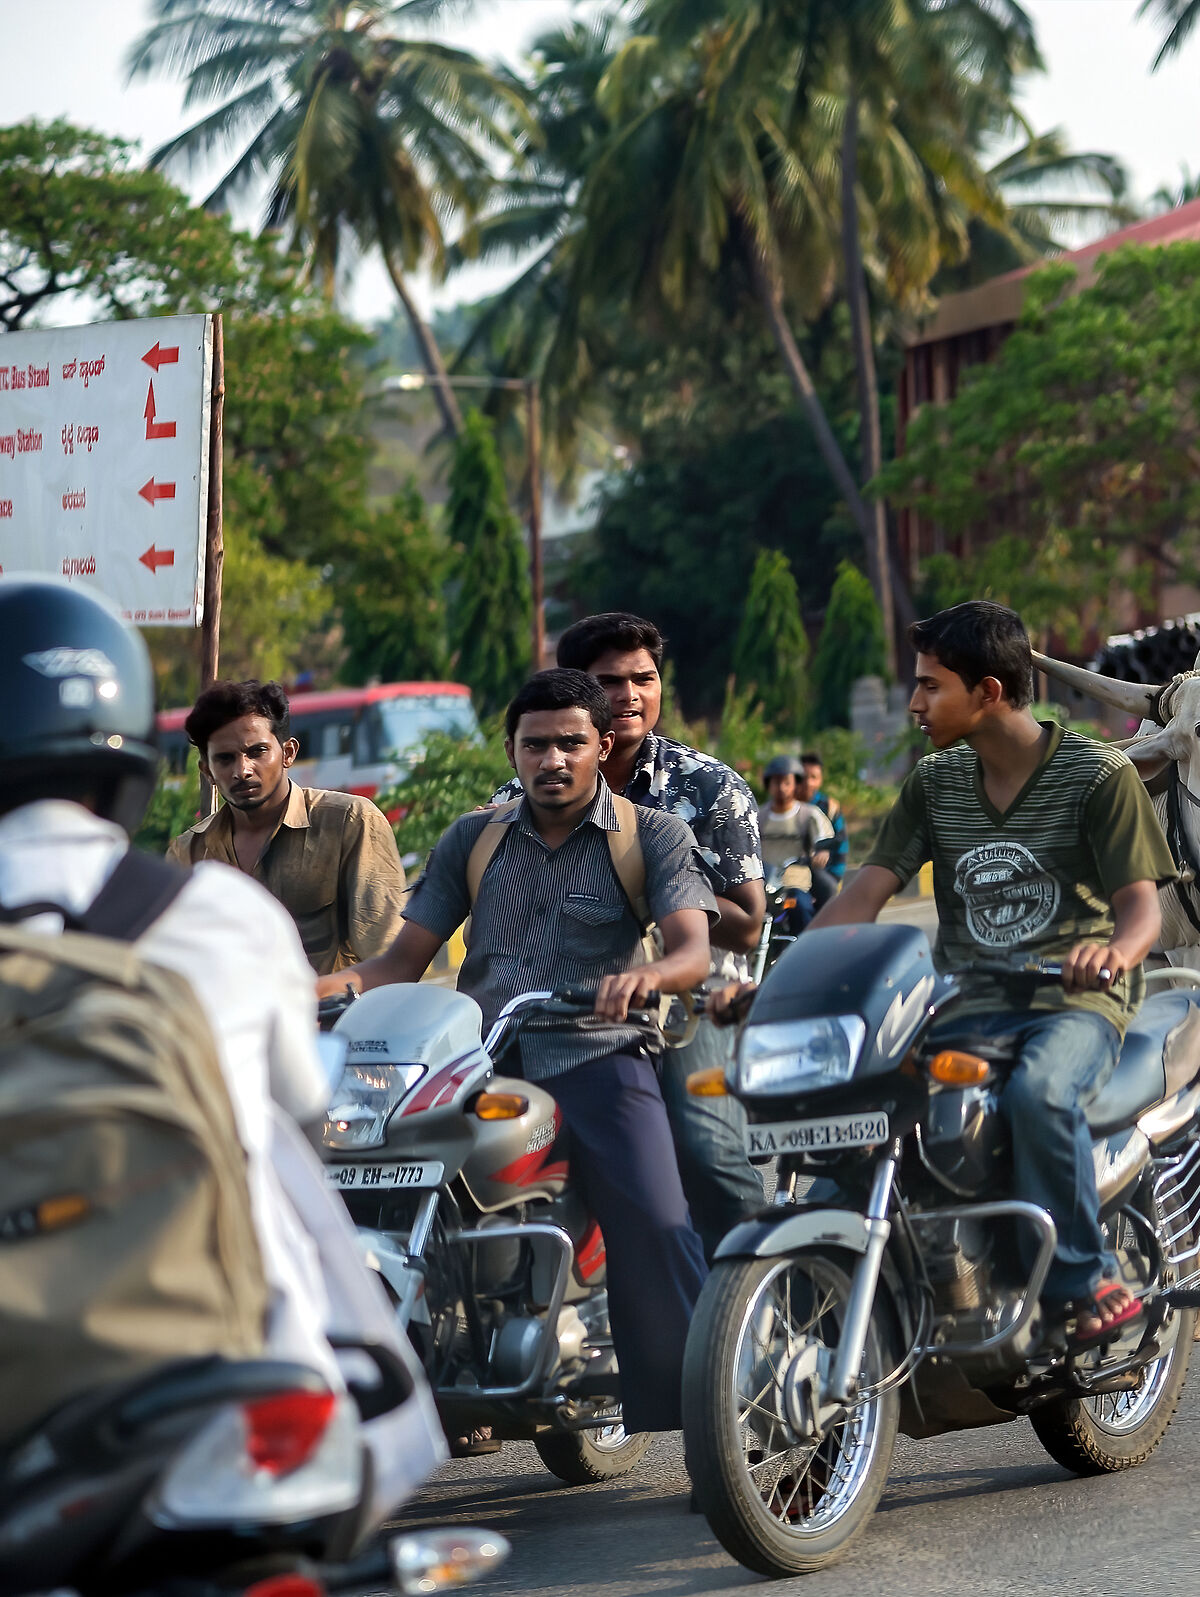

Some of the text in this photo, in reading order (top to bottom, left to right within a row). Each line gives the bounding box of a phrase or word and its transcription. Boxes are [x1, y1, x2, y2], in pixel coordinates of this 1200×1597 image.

[11, 365, 26, 391] Bus
[28, 362, 50, 388] Stand
[17, 428, 42, 452] Station
[749, 1130, 778, 1151] KA
